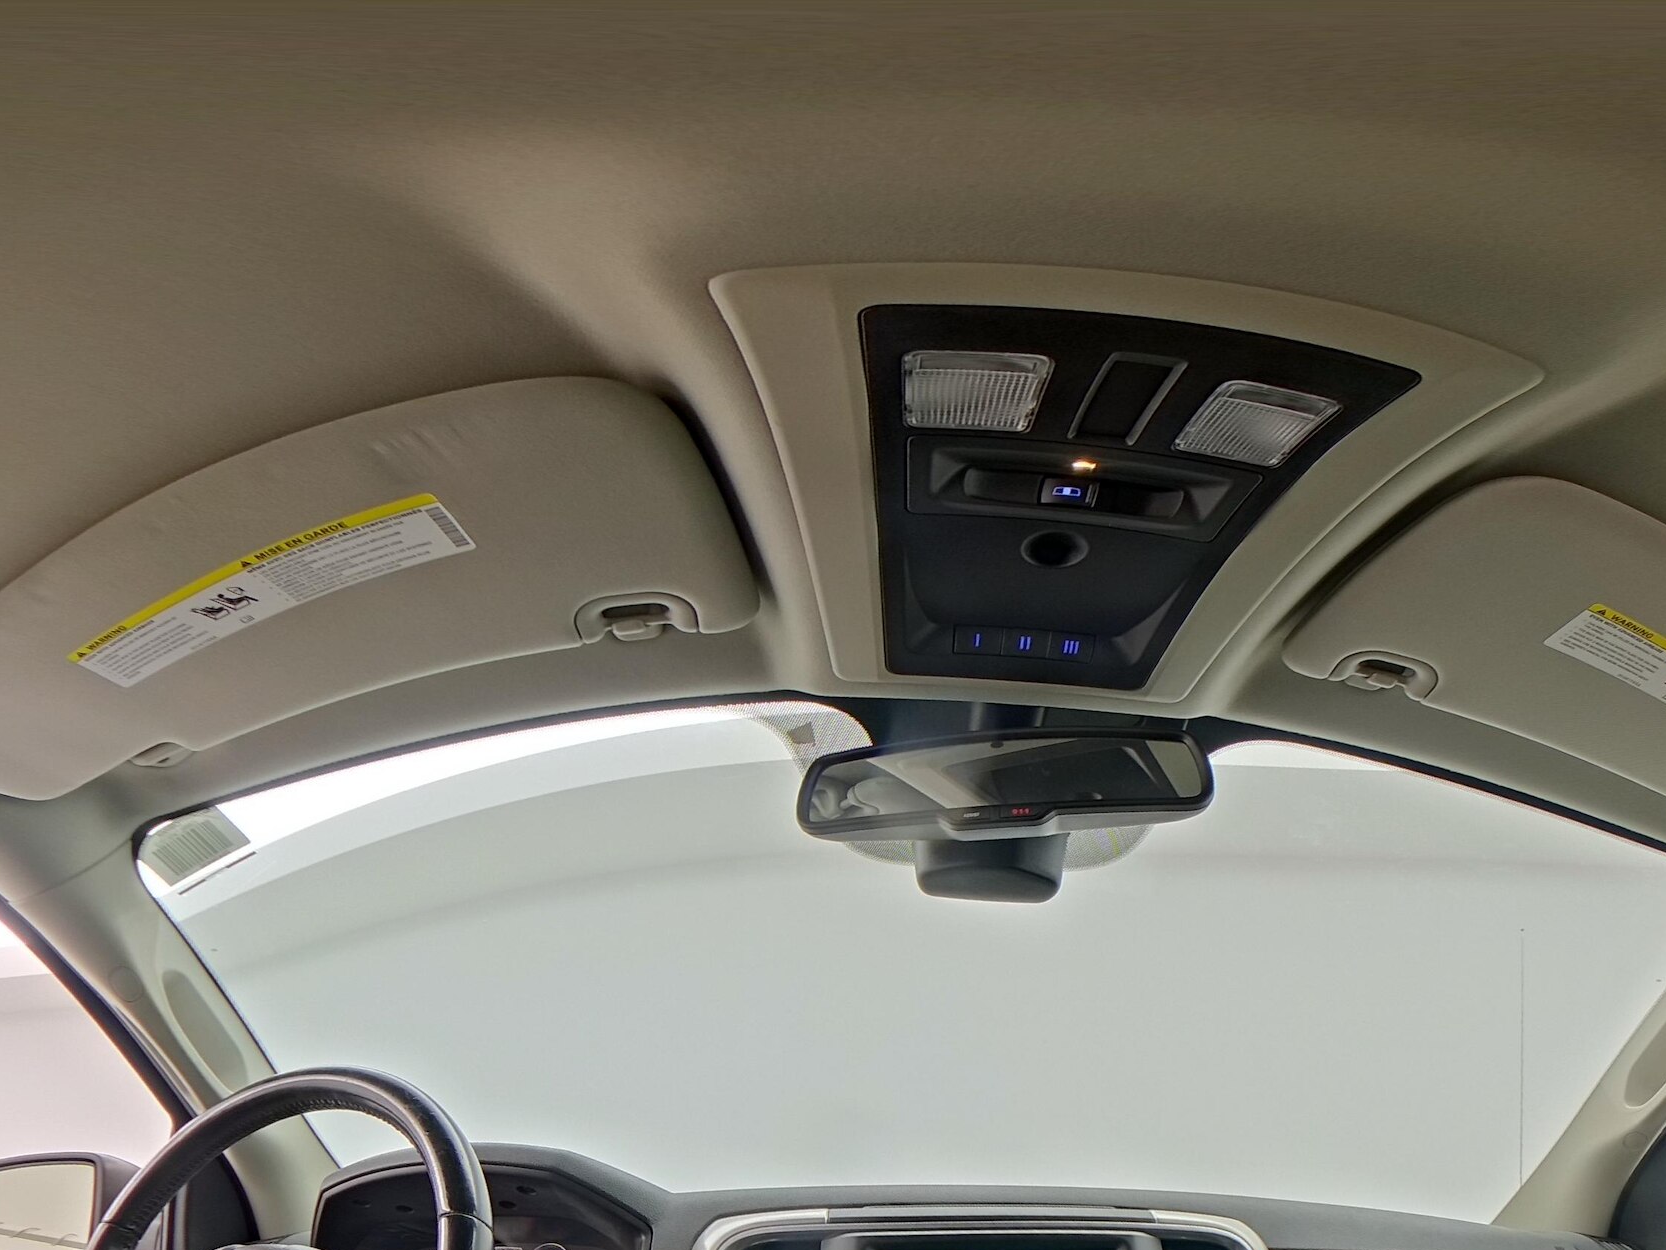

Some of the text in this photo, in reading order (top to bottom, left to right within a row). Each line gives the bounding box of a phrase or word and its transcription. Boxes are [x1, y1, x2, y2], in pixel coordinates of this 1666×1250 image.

[253, 545, 285, 561] MISE
[285, 537, 303, 548] EN
[303, 521, 349, 541] GARDE
[85, 625, 127, 651] WARNING
[1611, 614, 1654, 639] WARNING
